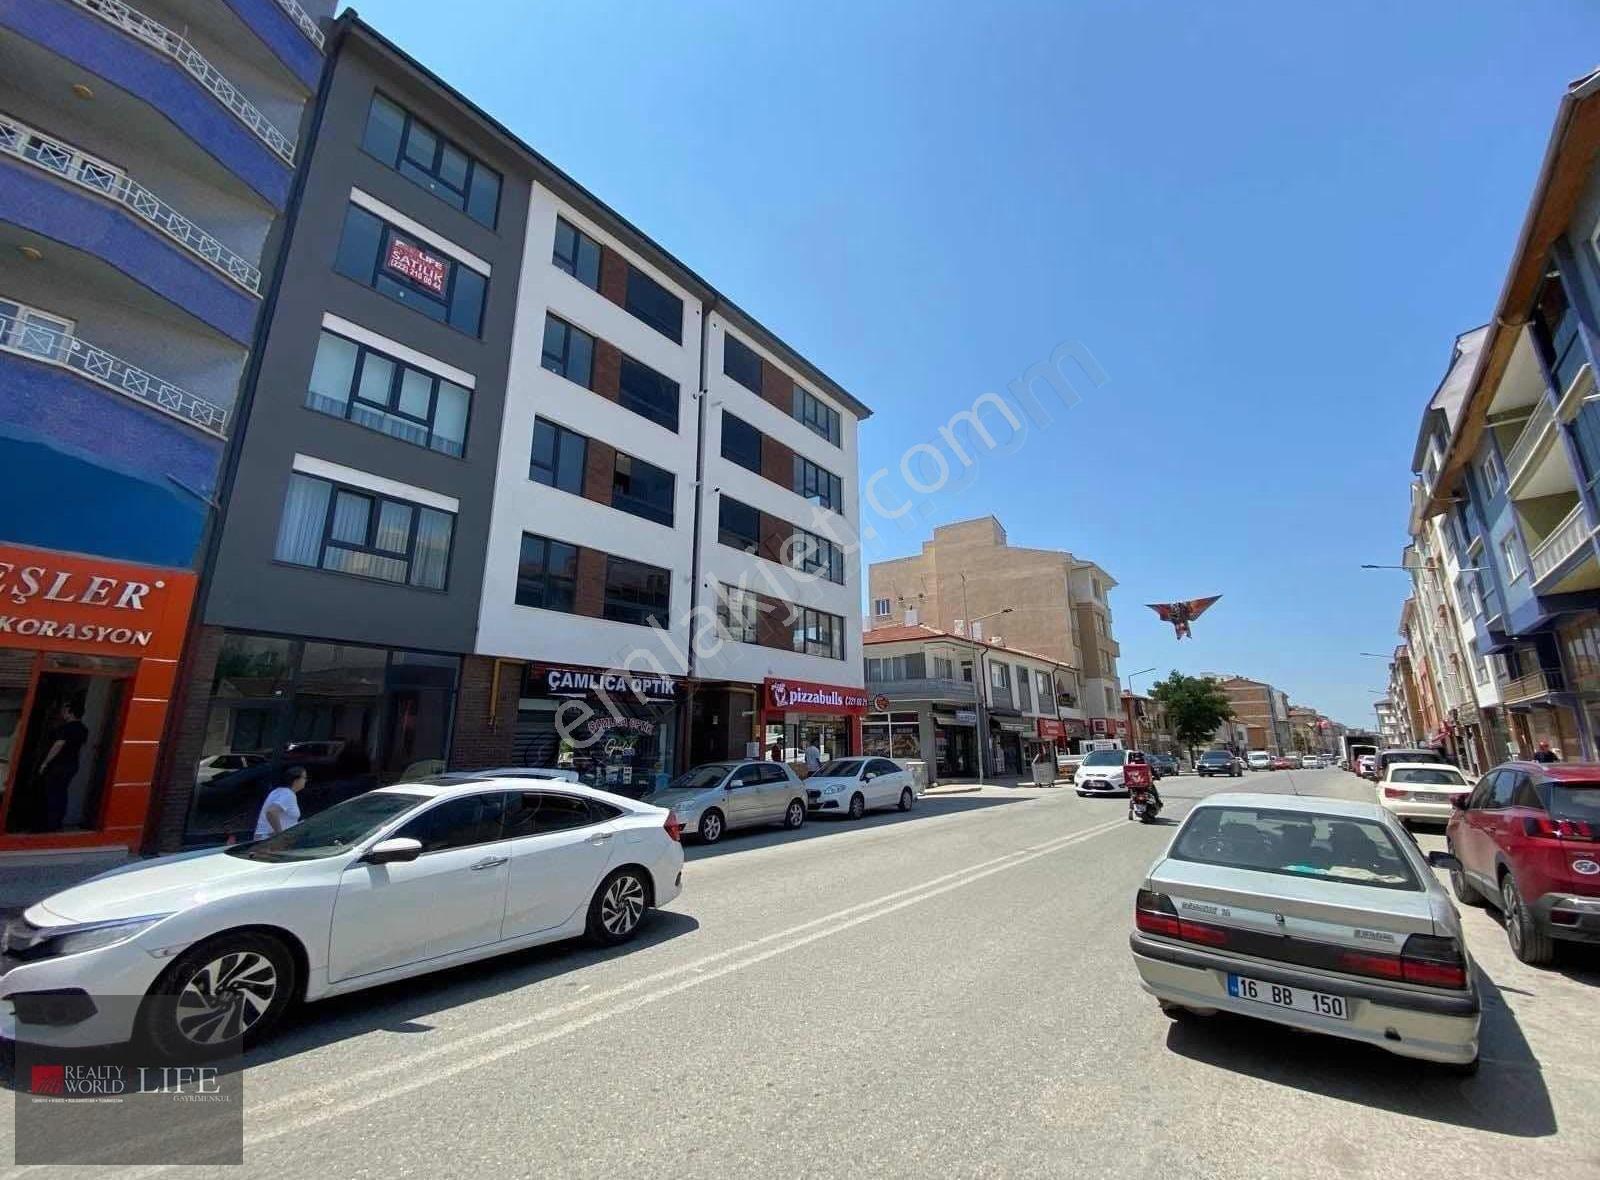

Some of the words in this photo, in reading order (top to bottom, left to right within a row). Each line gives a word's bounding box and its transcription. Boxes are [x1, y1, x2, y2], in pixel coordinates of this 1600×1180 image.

[391, 250, 442, 283] SATILIK
[548, 671, 626, 692] ÇAMLICA
[631, 675, 675, 695] OPTİK
[789, 687, 843, 706] pizzabulls
[1241, 979, 1258, 998] 16
[1272, 986, 1293, 1006] BB
[1312, 993, 1343, 1016] 150
